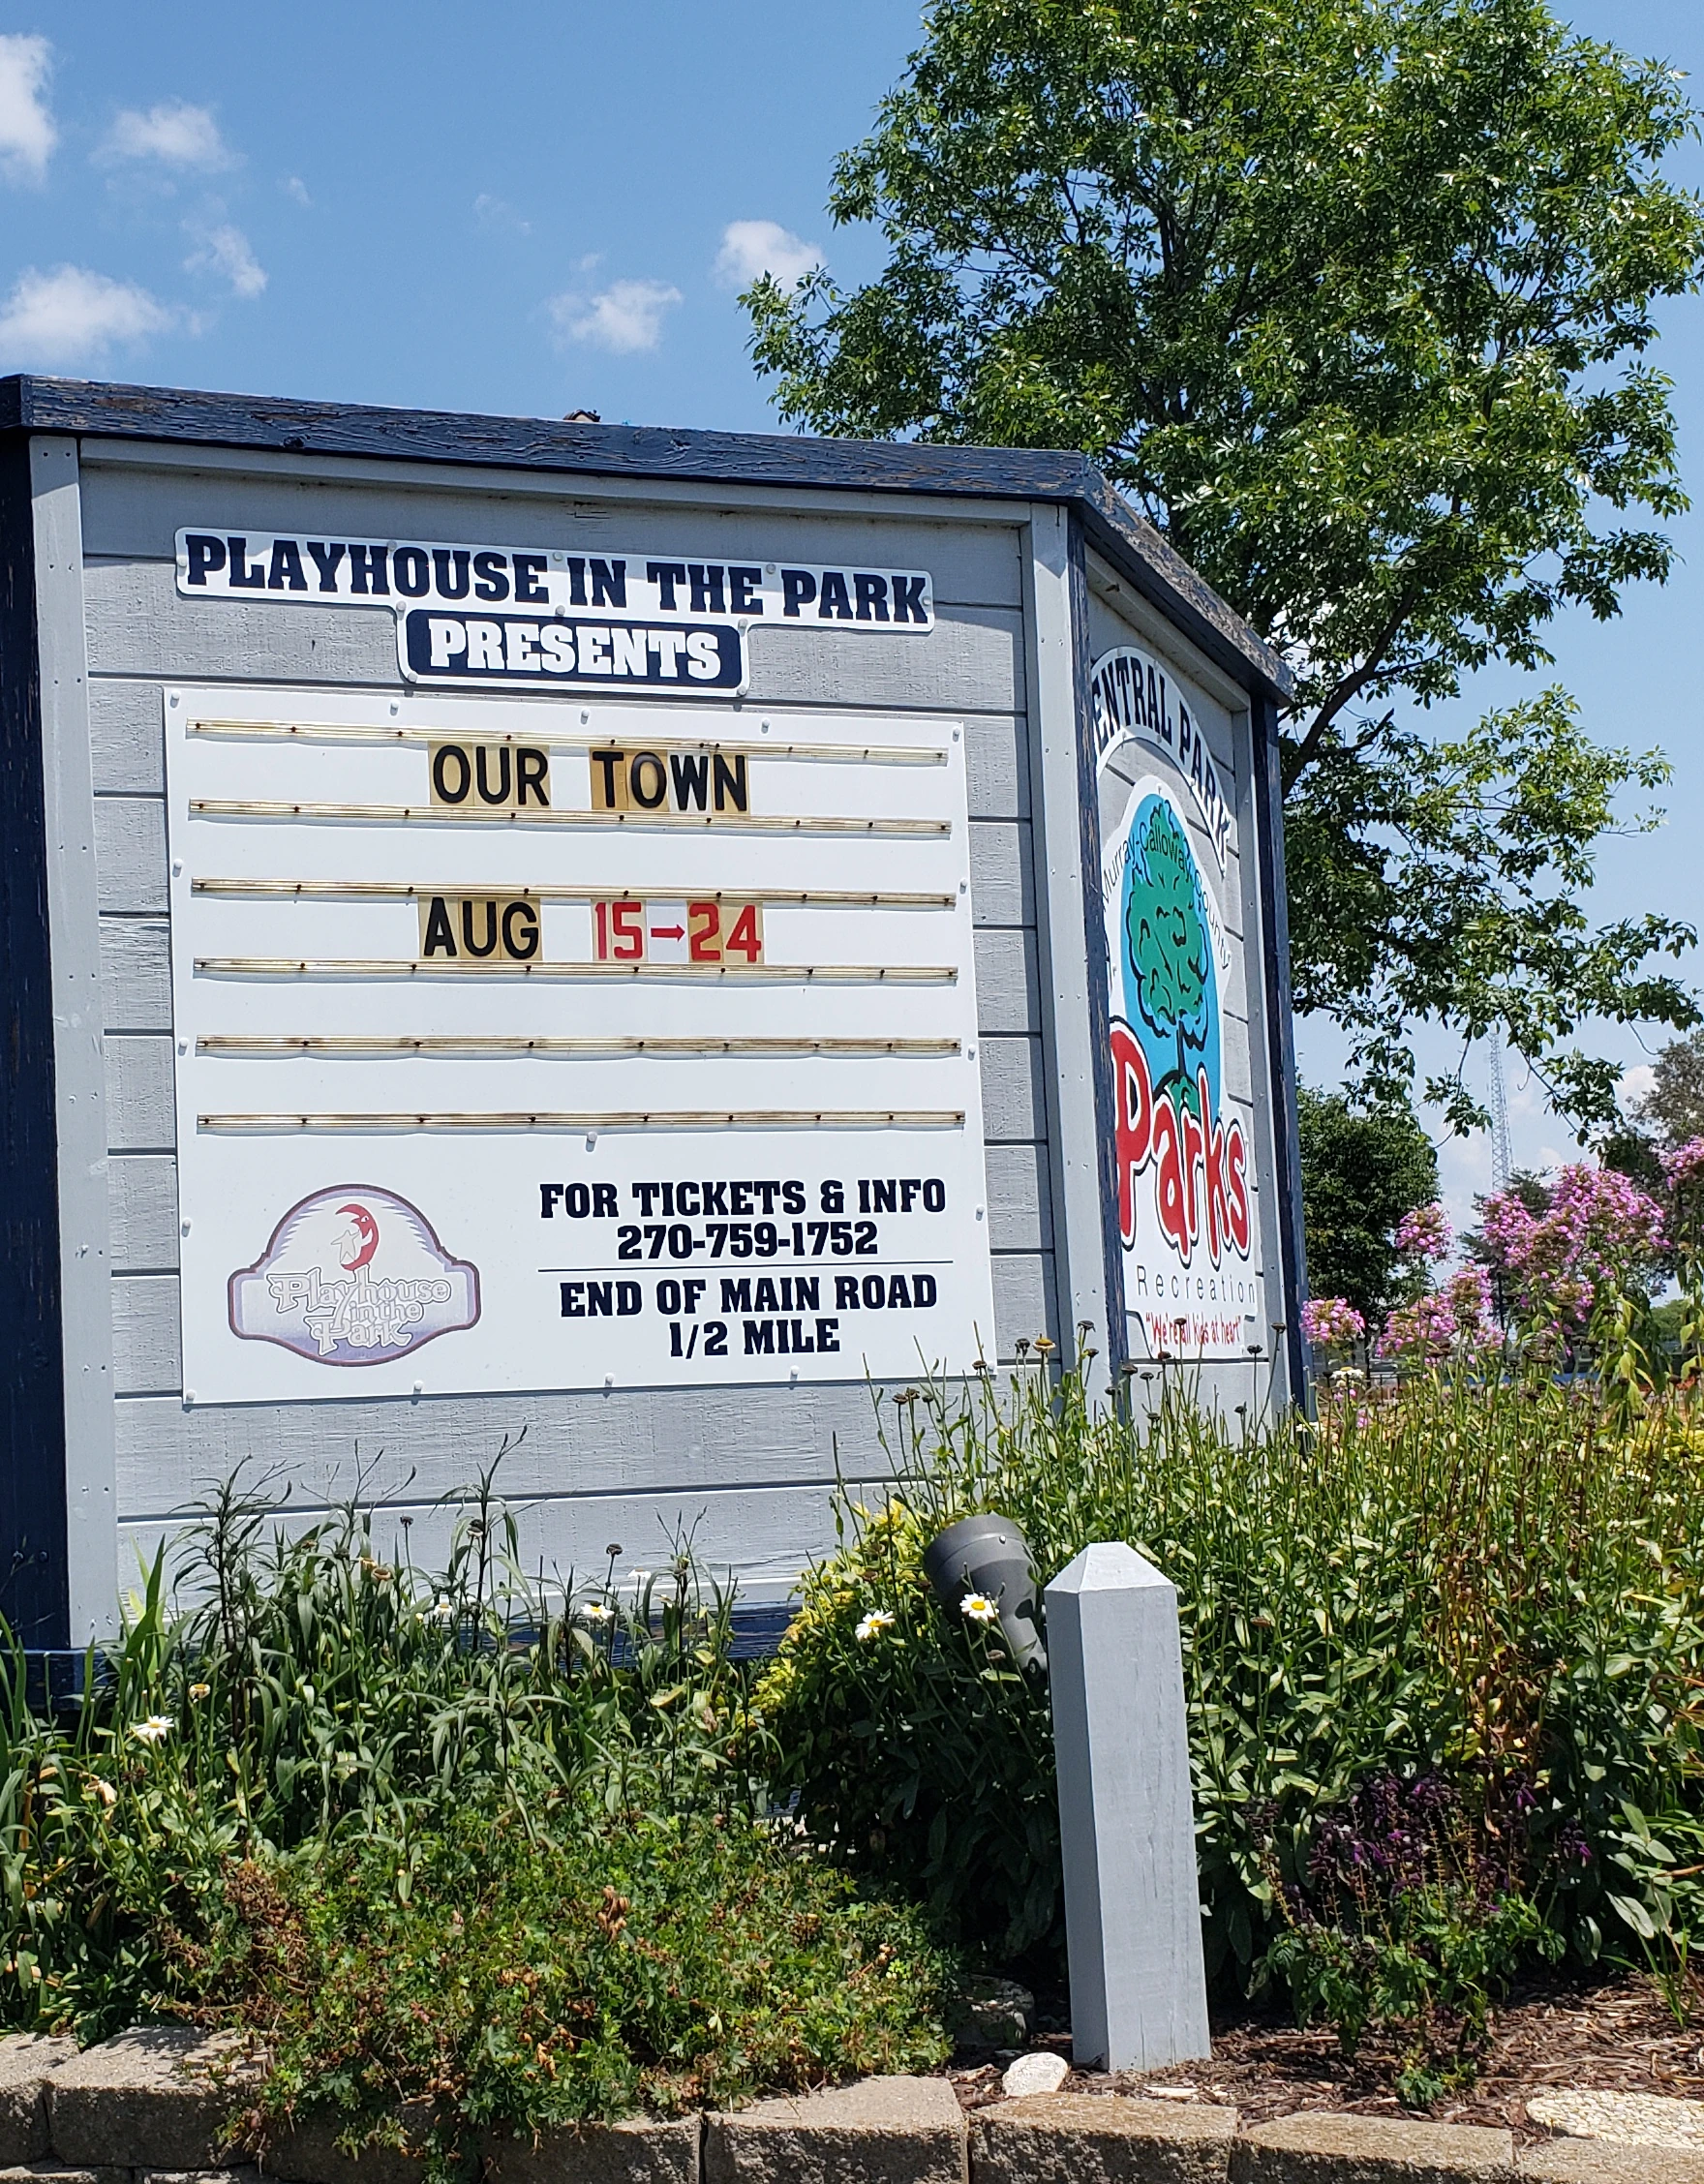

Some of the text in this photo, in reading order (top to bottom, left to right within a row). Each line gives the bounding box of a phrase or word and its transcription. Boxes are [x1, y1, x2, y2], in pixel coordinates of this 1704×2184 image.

[185, 533, 928, 624] PLAYHOUSE IN THE PARK
[428, 618, 722, 681] PRESENTS
[433, 744, 747, 812] OUR TOWN
[1091, 656, 1231, 864] ENTRAL PARK
[423, 896, 539, 960] AUG
[1194, 868, 1232, 970] County
[1110, 1016, 1252, 1271] Parks
[539, 1178, 946, 1218] FOR TICKETS & INFO
[617, 1221, 878, 1259] 270-759-1752
[266, 1266, 451, 1328] Playhouse
[350, 1297, 423, 1323] in the
[560, 1274, 937, 1318] END OF MAIN ROAD
[1137, 1264, 1256, 1304] Recreation
[305, 1315, 413, 1355] Park
[669, 1318, 840, 1359] 1/2 MILE
[1192, 1312, 1209, 1346] kids
[1211, 1314, 1220, 1345] at
